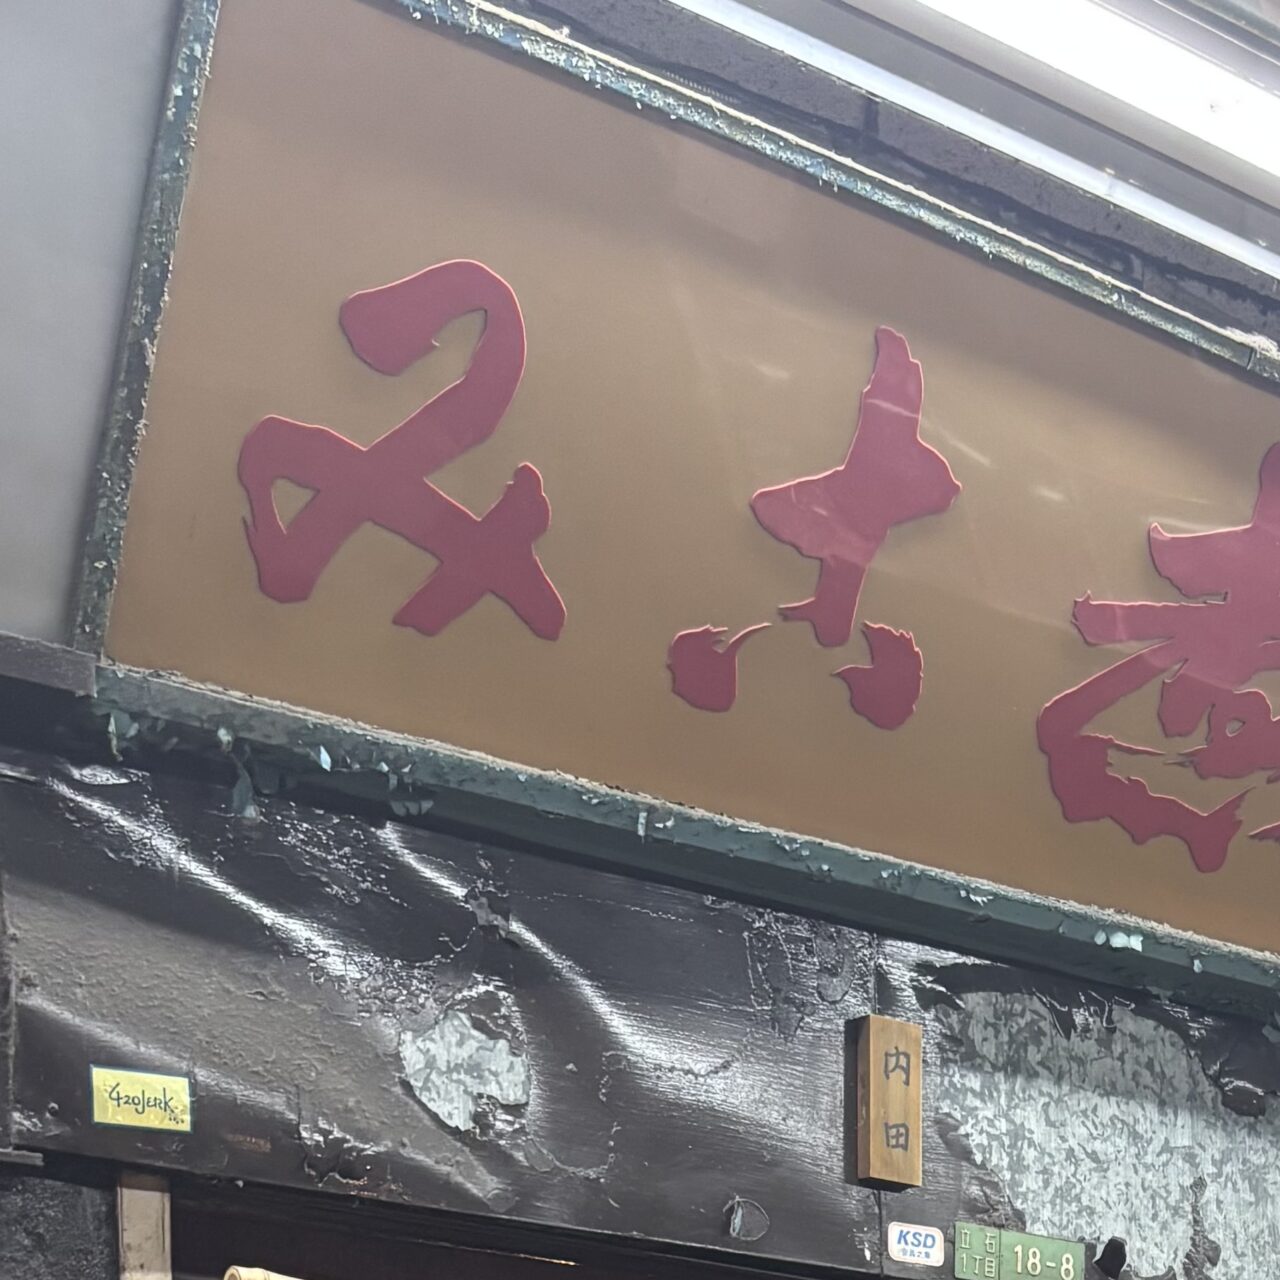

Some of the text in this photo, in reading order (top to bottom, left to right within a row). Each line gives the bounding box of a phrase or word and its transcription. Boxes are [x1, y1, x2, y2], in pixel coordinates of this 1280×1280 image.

[883, 1046, 912, 1153] 内田
[896, 1229, 936, 1250] KSD
[960, 1228, 998, 1254] 立石
[960, 1252, 997, 1279] 1丁目
